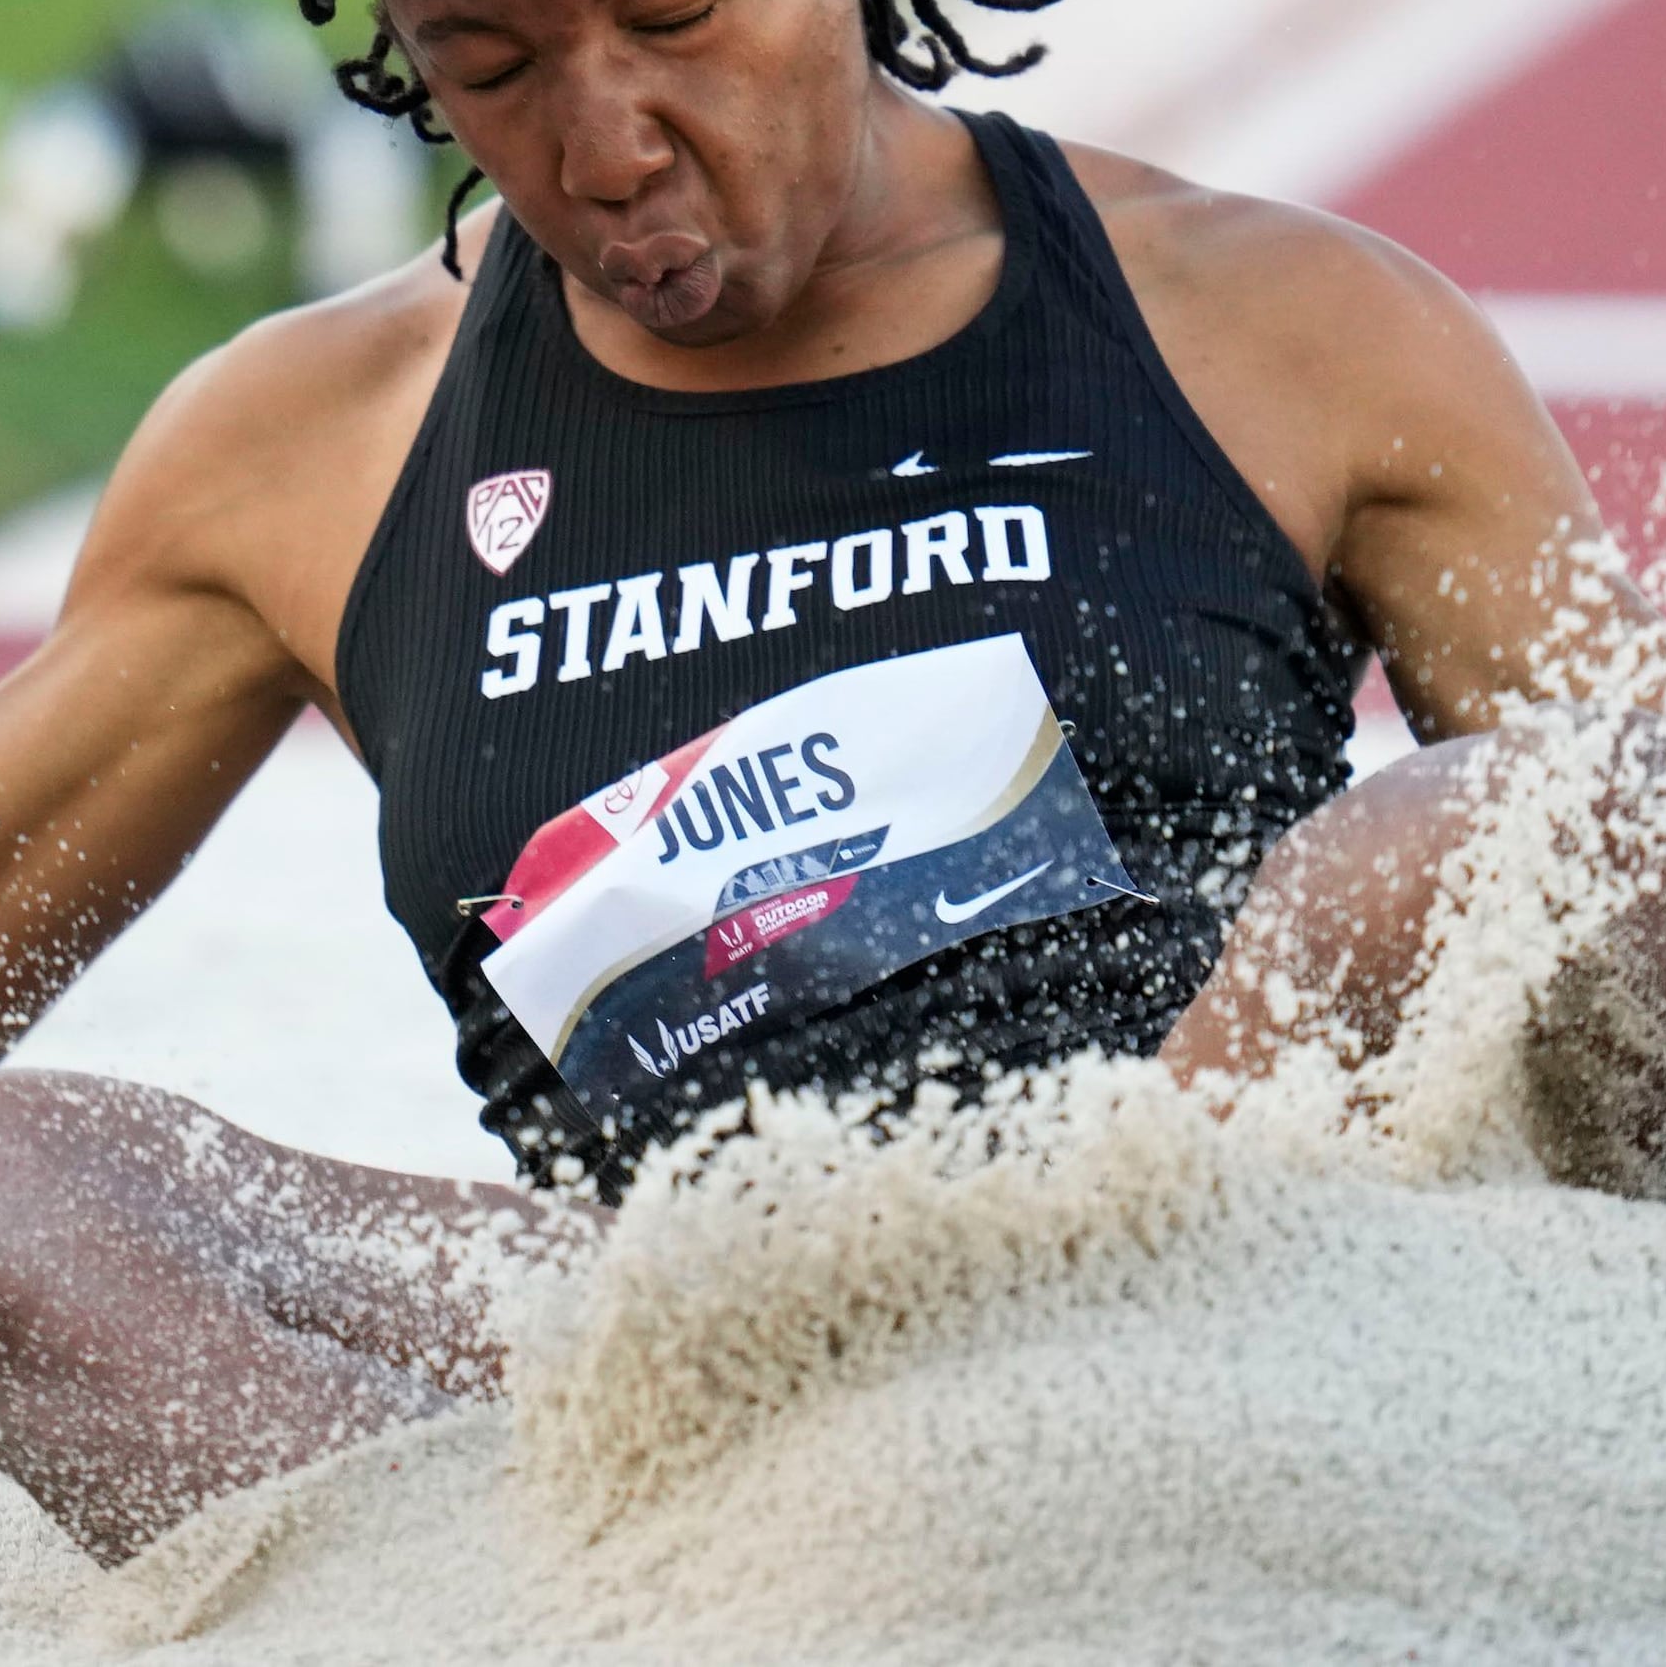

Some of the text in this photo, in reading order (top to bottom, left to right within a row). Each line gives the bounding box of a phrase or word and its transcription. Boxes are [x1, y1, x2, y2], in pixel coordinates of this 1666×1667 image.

[473, 476, 544, 539] PAC
[486, 515, 524, 554] 12
[481, 504, 1051, 700] STANFORD
[655, 732, 856, 865] JUNES
[754, 890, 830, 929] OUTDOOR
[727, 941, 754, 962] USATF
[675, 982, 771, 1055] USATF
